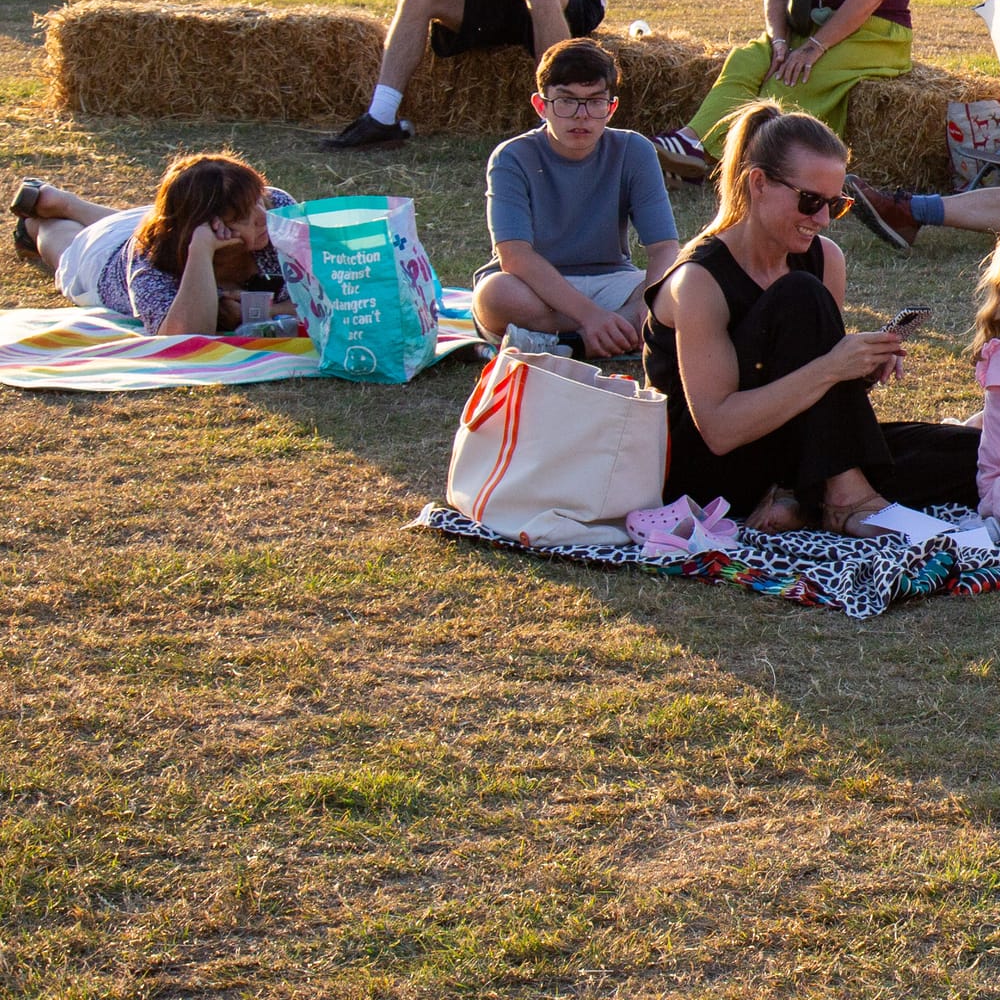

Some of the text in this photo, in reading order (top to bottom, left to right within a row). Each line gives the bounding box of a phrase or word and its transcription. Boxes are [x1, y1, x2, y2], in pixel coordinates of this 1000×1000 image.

[323, 251, 380, 265] Protection
[331, 266, 370, 283] against
[341, 282, 360, 296] the
[332, 298, 376, 314] dangers
[352, 310, 381, 325] can't
